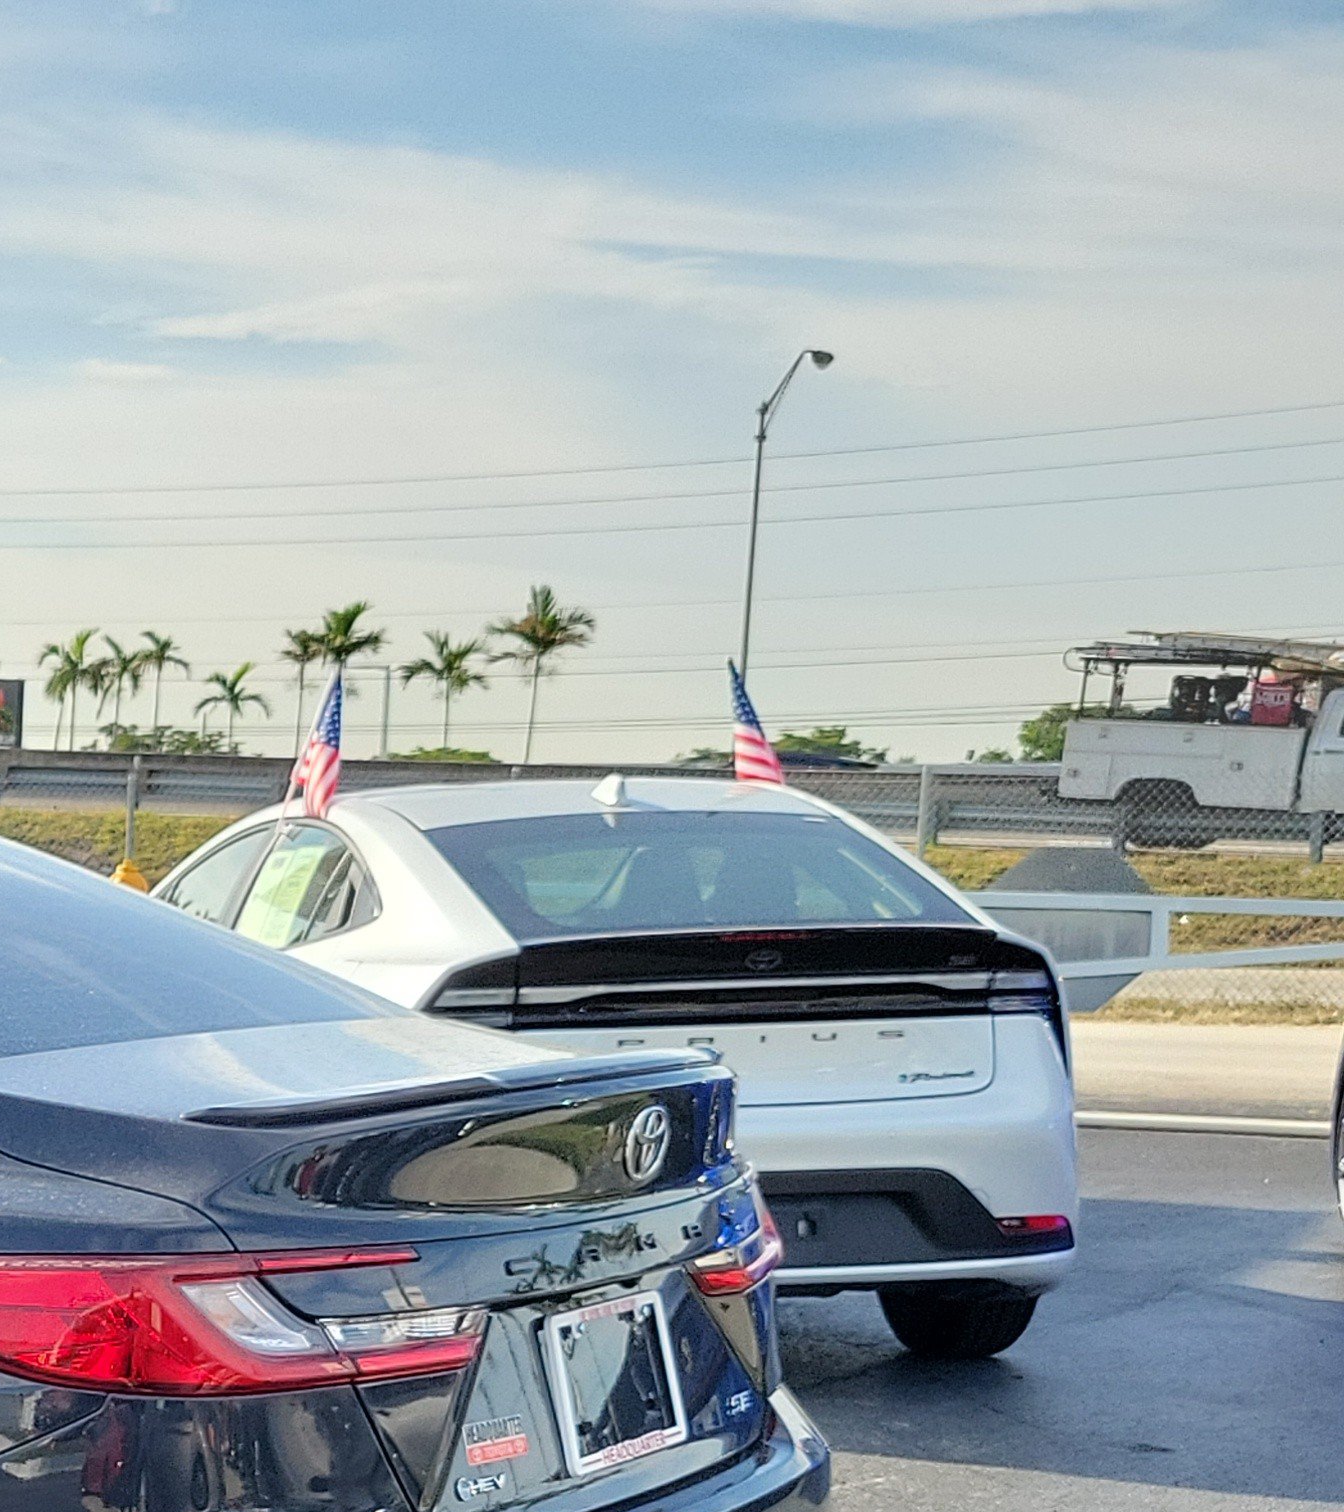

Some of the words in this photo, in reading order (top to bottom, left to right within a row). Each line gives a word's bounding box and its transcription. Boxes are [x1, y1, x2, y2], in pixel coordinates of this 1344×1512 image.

[617, 1029, 905, 1047] PRIUS
[602, 1433, 666, 1463] HEADQUARTER
[469, 1472, 506, 1496] HEV
